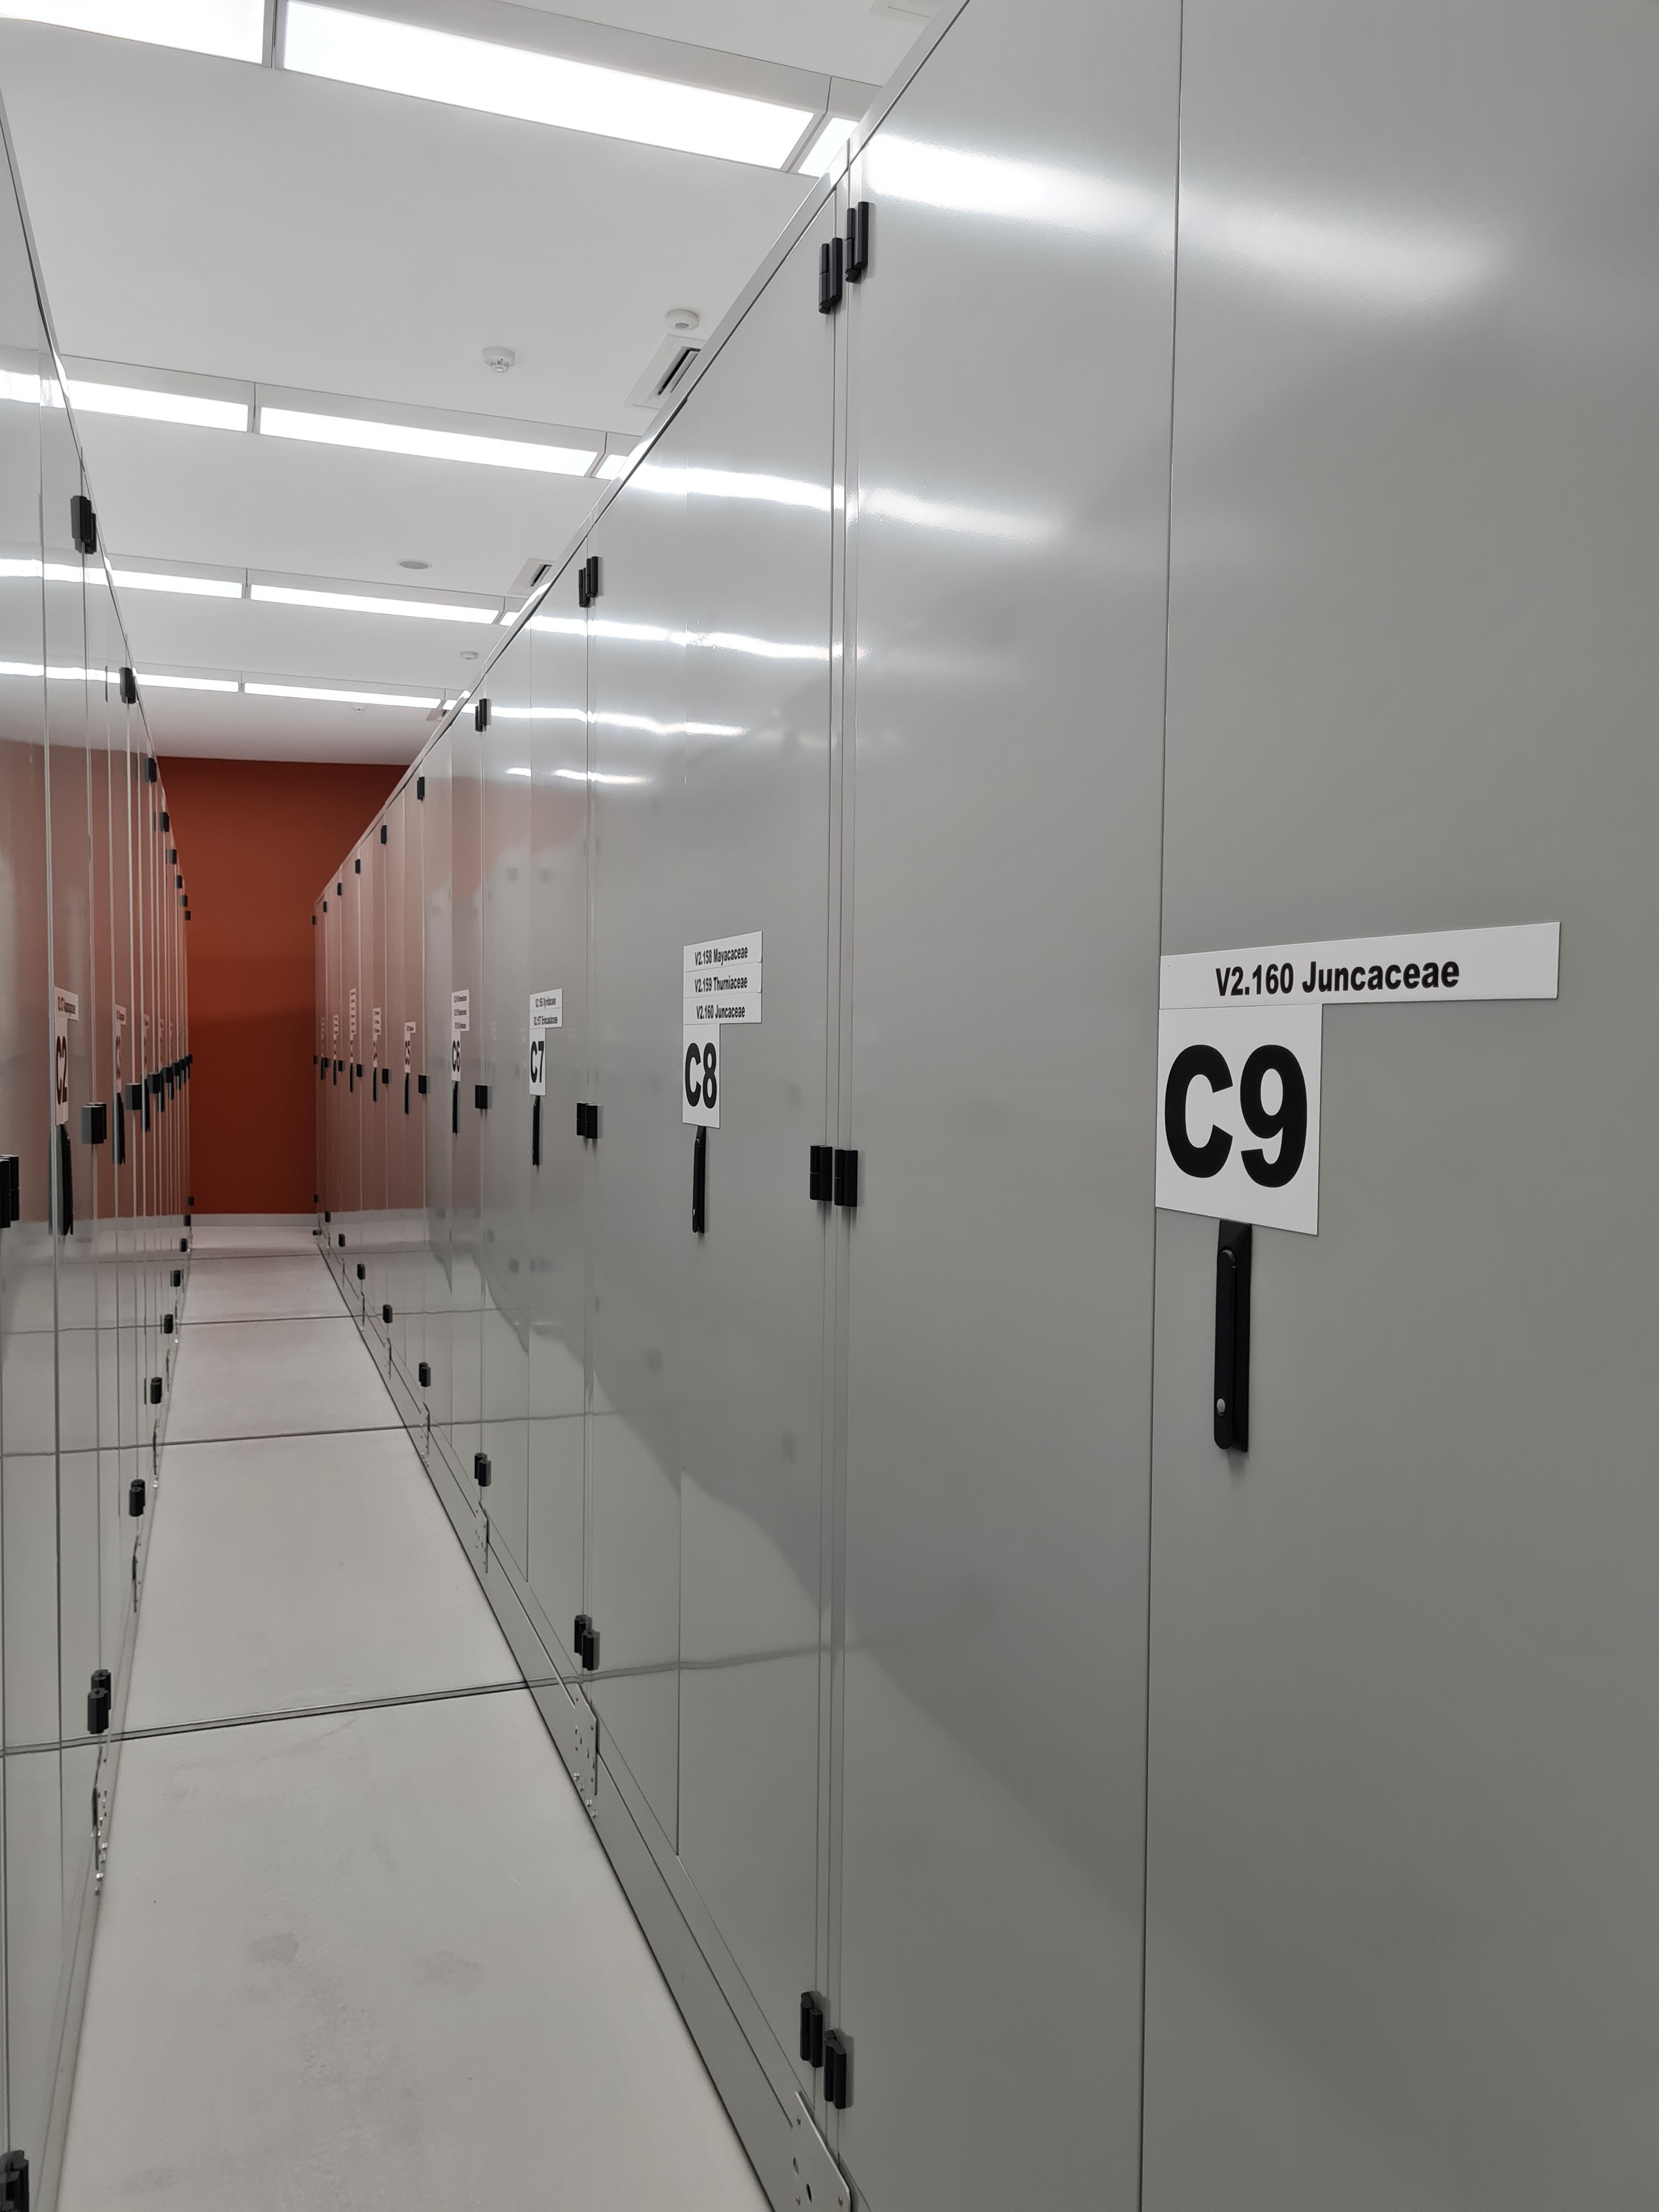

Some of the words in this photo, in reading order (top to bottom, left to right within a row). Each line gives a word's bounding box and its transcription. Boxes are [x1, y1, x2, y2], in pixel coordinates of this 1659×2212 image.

[695, 949, 712, 966] V2.158
[714, 947, 748, 966] Mayacaceae
[695, 977, 712, 993] V2.159
[713, 975, 748, 991] Thurniaceae
[1216, 963, 1294, 996] V2.160
[1302, 961, 1460, 992] Juncaceae
[696, 1005, 714, 1020] V2.160
[715, 1004, 746, 1019] Juncaceae
[56, 1035, 67, 1105] C2
[452, 1040, 460, 1072] C6
[531, 1041, 545, 1083] C7
[685, 1042, 717, 1109] C8
[1164, 1045, 1307, 1188] C9
